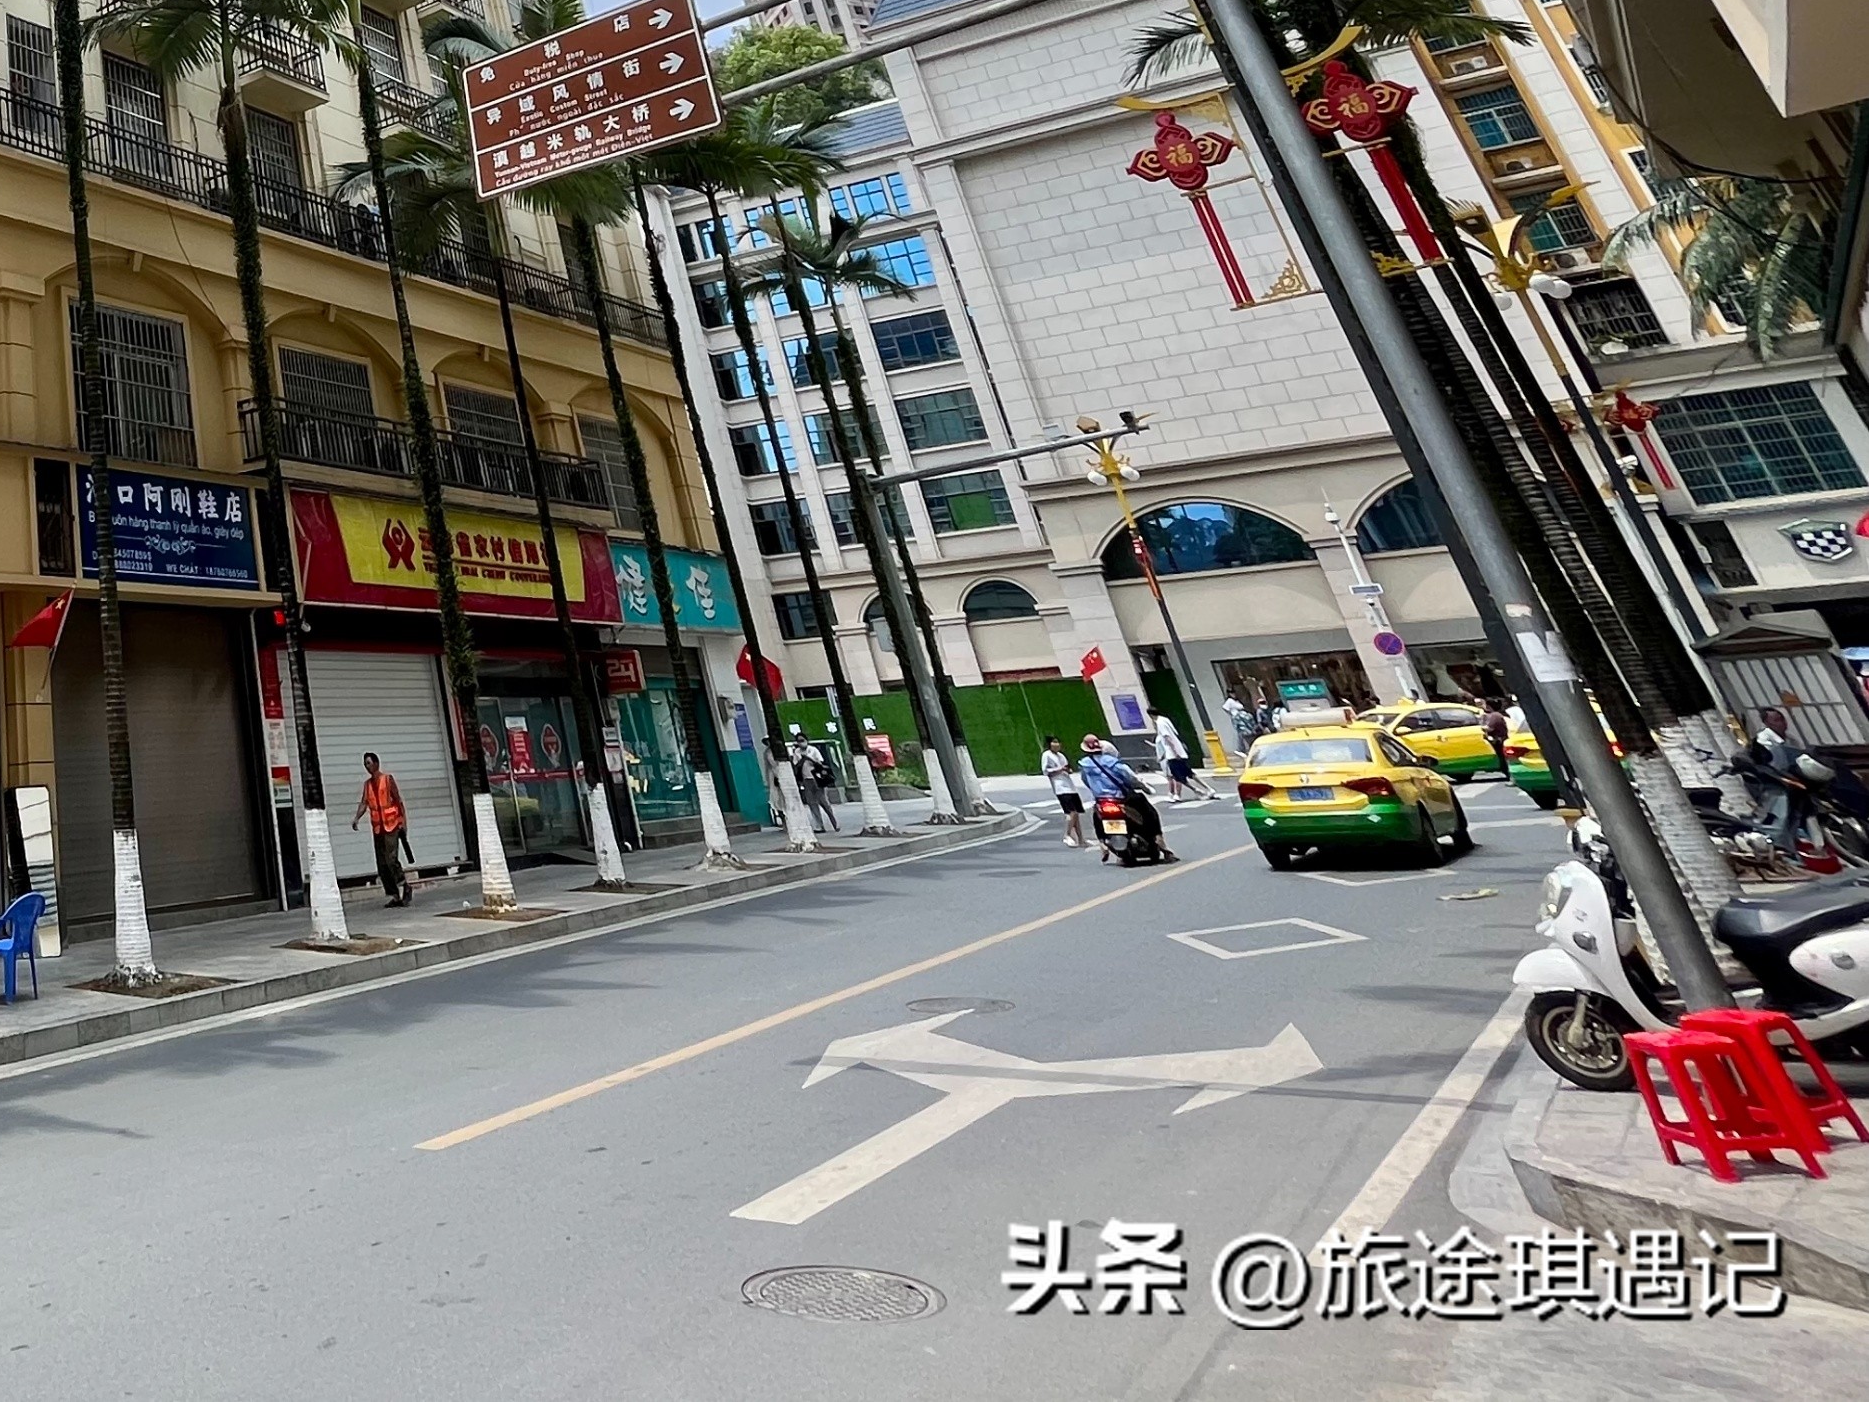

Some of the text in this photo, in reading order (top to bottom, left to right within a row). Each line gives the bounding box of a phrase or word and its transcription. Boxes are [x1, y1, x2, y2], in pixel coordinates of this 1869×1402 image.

[480, 14, 630, 83] 免税店
[565, 50, 585, 61] Shop
[486, 58, 640, 125] 异域风情街
[584, 88, 608, 102] Street
[1339, 95, 1368, 118] 福
[492, 102, 650, 169] 滇越米轨大桥
[1166, 143, 1193, 166] 福
[417, 526, 551, 567] 云省农村信用
[606, 658, 637, 682] 24
